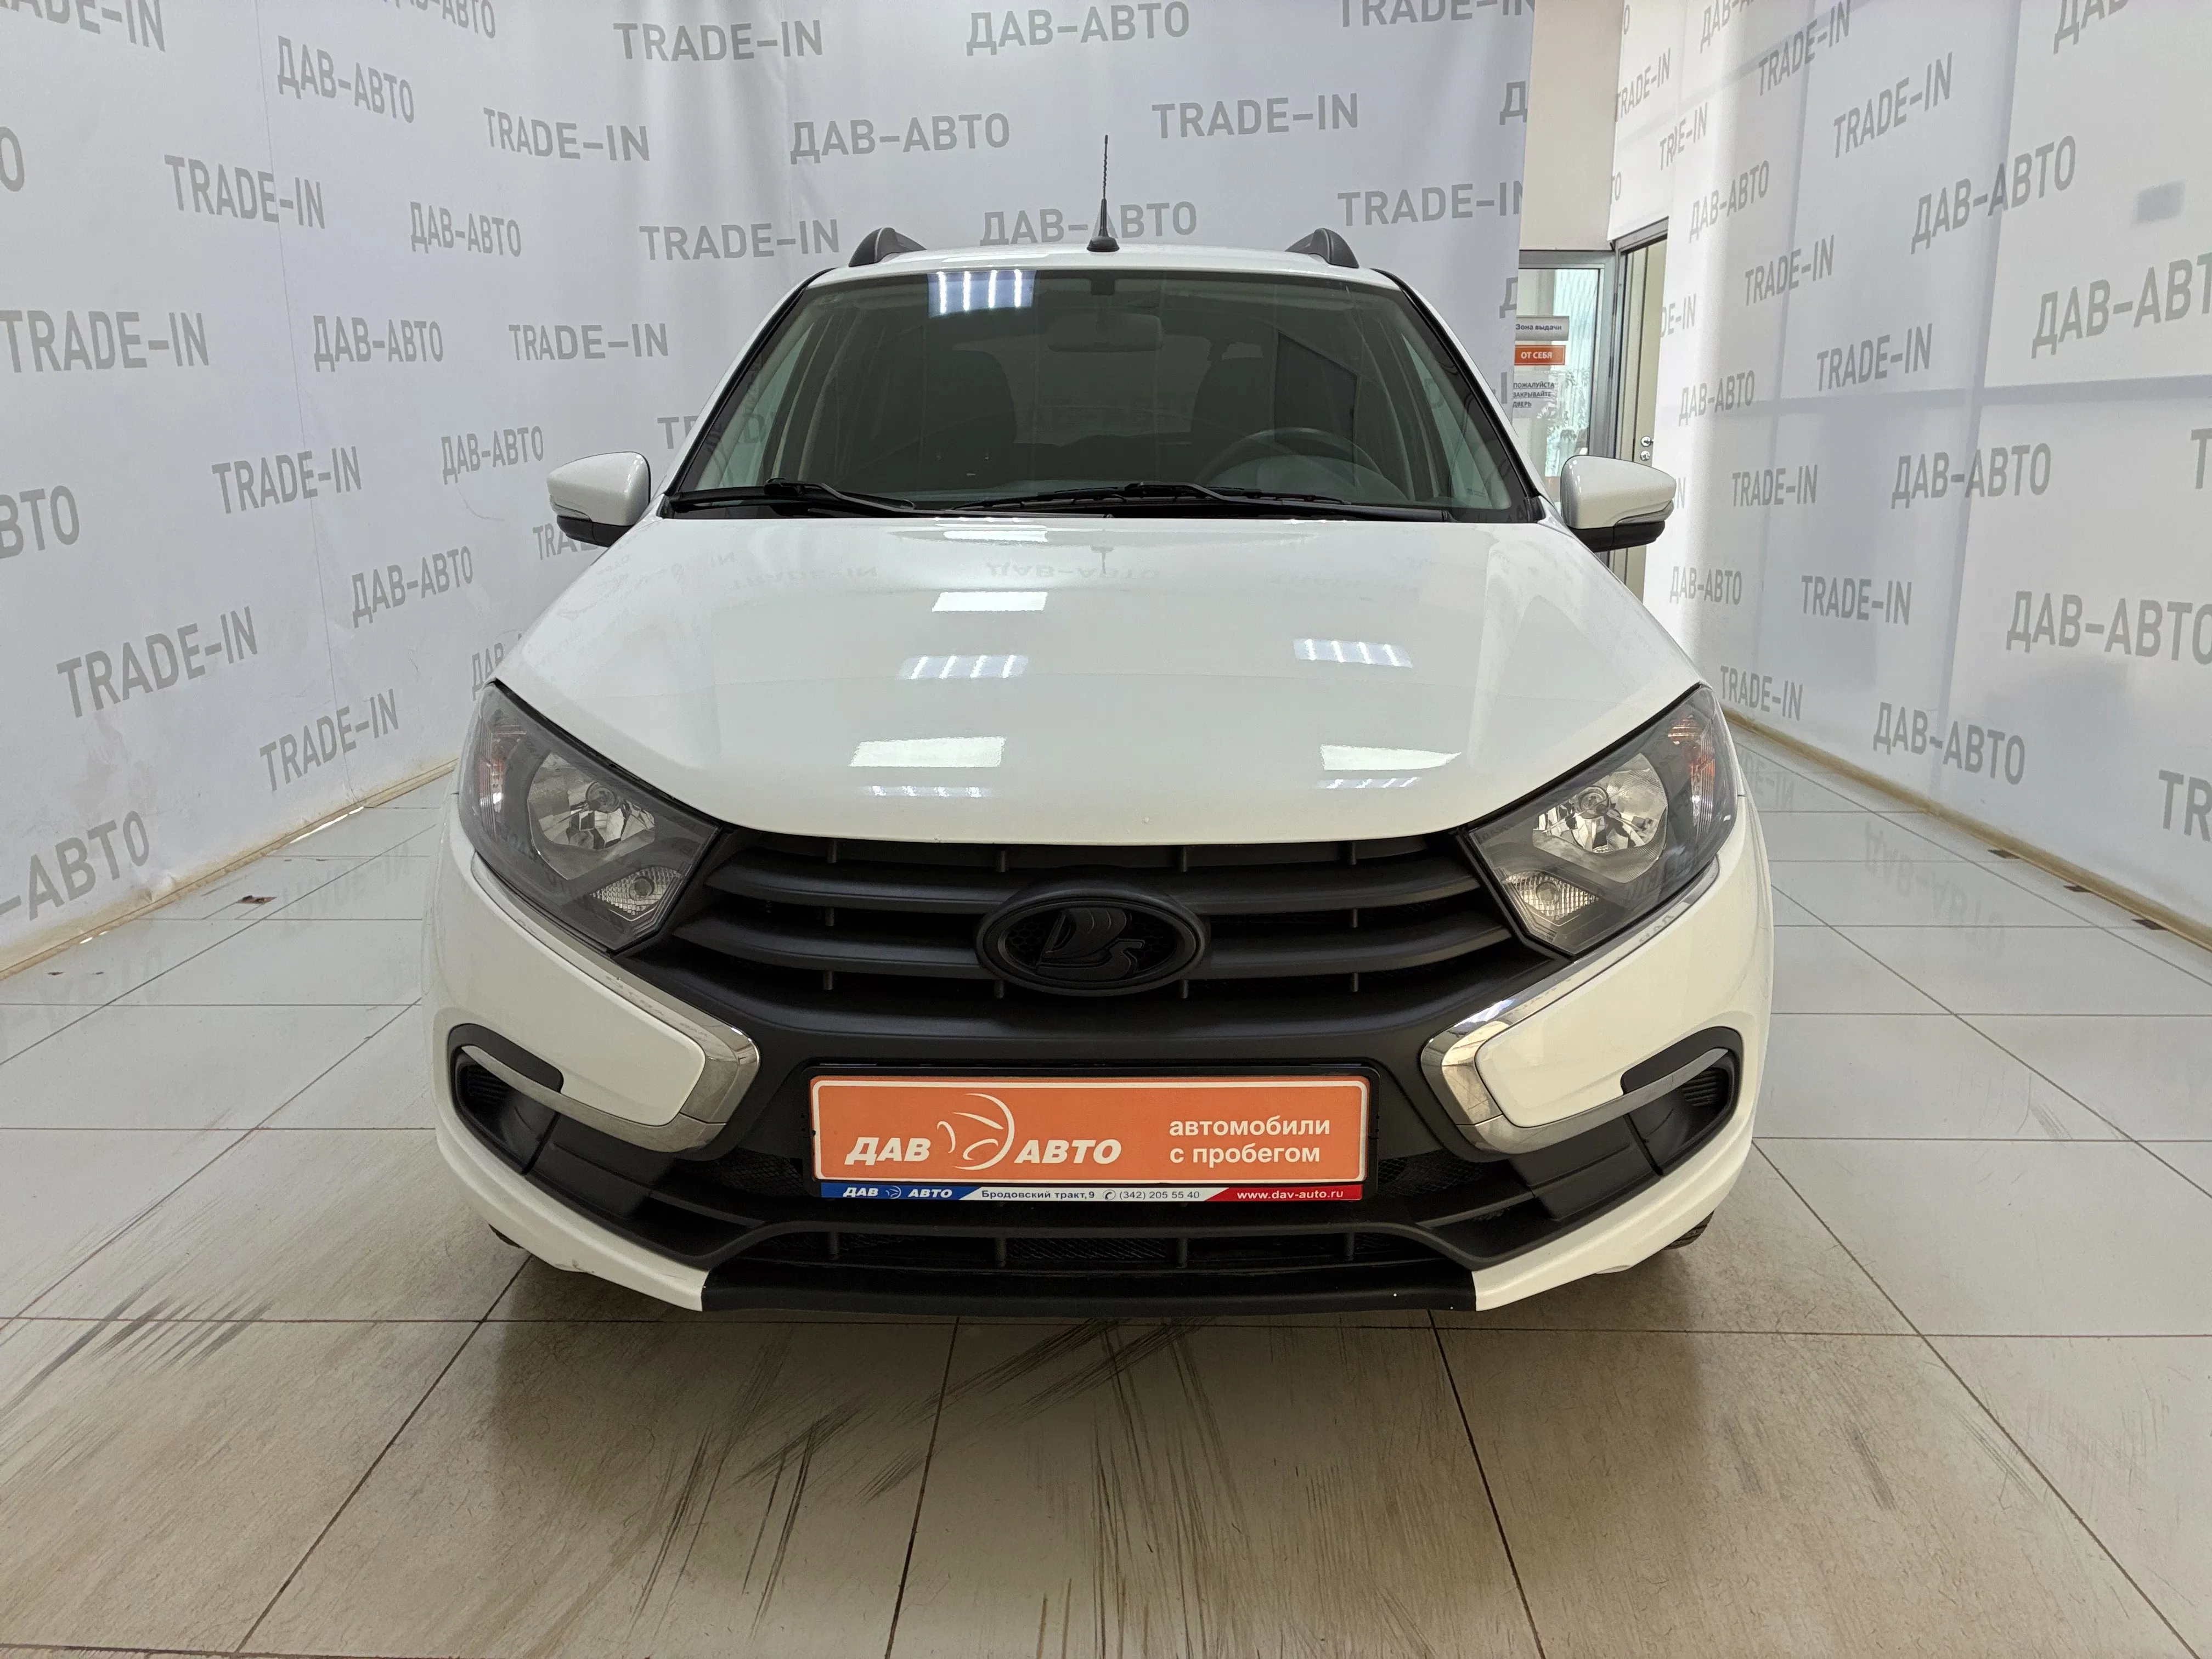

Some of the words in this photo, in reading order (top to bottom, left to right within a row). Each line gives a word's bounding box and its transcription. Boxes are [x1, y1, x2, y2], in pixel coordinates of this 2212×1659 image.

[613, 20, 823, 61] TRADE-IN
[966, 1, 1189, 56] ДАВ-АВТО
[1759, 0, 1850, 96] TRADE-IN
[278, 36, 414, 123] ДАВ-АВТО
[1834, 52, 1953, 158] TRADE-IN
[484, 108, 650, 161] TRADE-IN
[791, 113, 1009, 165] ДАВ-АВТО
[1152, 93, 1358, 139] TRADE-IN
[165, 155, 325, 229] TRADE-IN
[1689, 160, 1769, 243] ДАВ-АВТО
[1911, 135, 2076, 254] ДАВ-АВТО
[410, 201, 522, 257] ДАВ-АВТО
[640, 219, 839, 260] TRADE-IN
[1745, 235, 1834, 306] TRADE-IN
[0, 310, 209, 373] TRADE-IN
[313, 315, 443, 372] ДАВ-АВТО
[509, 323, 669, 360] TRADE-IN
[1817, 323, 1932, 391] TRADE-IN
[1679, 370, 1755, 426] ДАВ-АВТО
[212, 446, 362, 514] TRADE-IN
[441, 426, 544, 484] ДАВ-АВТО
[1892, 443, 2051, 509] ДАВ-АВТО
[1732, 465, 1818, 507] TRADE-IN
[533, 523, 598, 560] TRA
[352, 546, 473, 628] ДАВ-АВТО
[1670, 566, 1742, 603] ДАВ-АВТО
[1801, 575, 1912, 625] TRADE-IN
[2006, 590, 2212, 664] ДАВ-АВТО
[57, 606, 258, 718] TRADE-IN
[1720, 665, 1803, 721] TRADE-IN
[259, 689, 399, 791] TRADE-IN
[1873, 702, 2025, 785] ДАВ-АВТО
[844, 1137, 931, 1165] ДАВ
[1014, 1139, 1122, 1164] АВТО
[1169, 1115, 1330, 1136] автомобили
[1170, 1148, 1184, 1163] с
[1193, 1143, 1320, 1168] пробегом
[842, 1187, 878, 1198] ДАВ
[907, 1189, 952, 1198] АВТО
[981, 1190, 1051, 1199] Бродовский
[1119, 1191, 1146, 1200] (342)
[1237, 1189, 1344, 1199] www.dav-auto.ru
